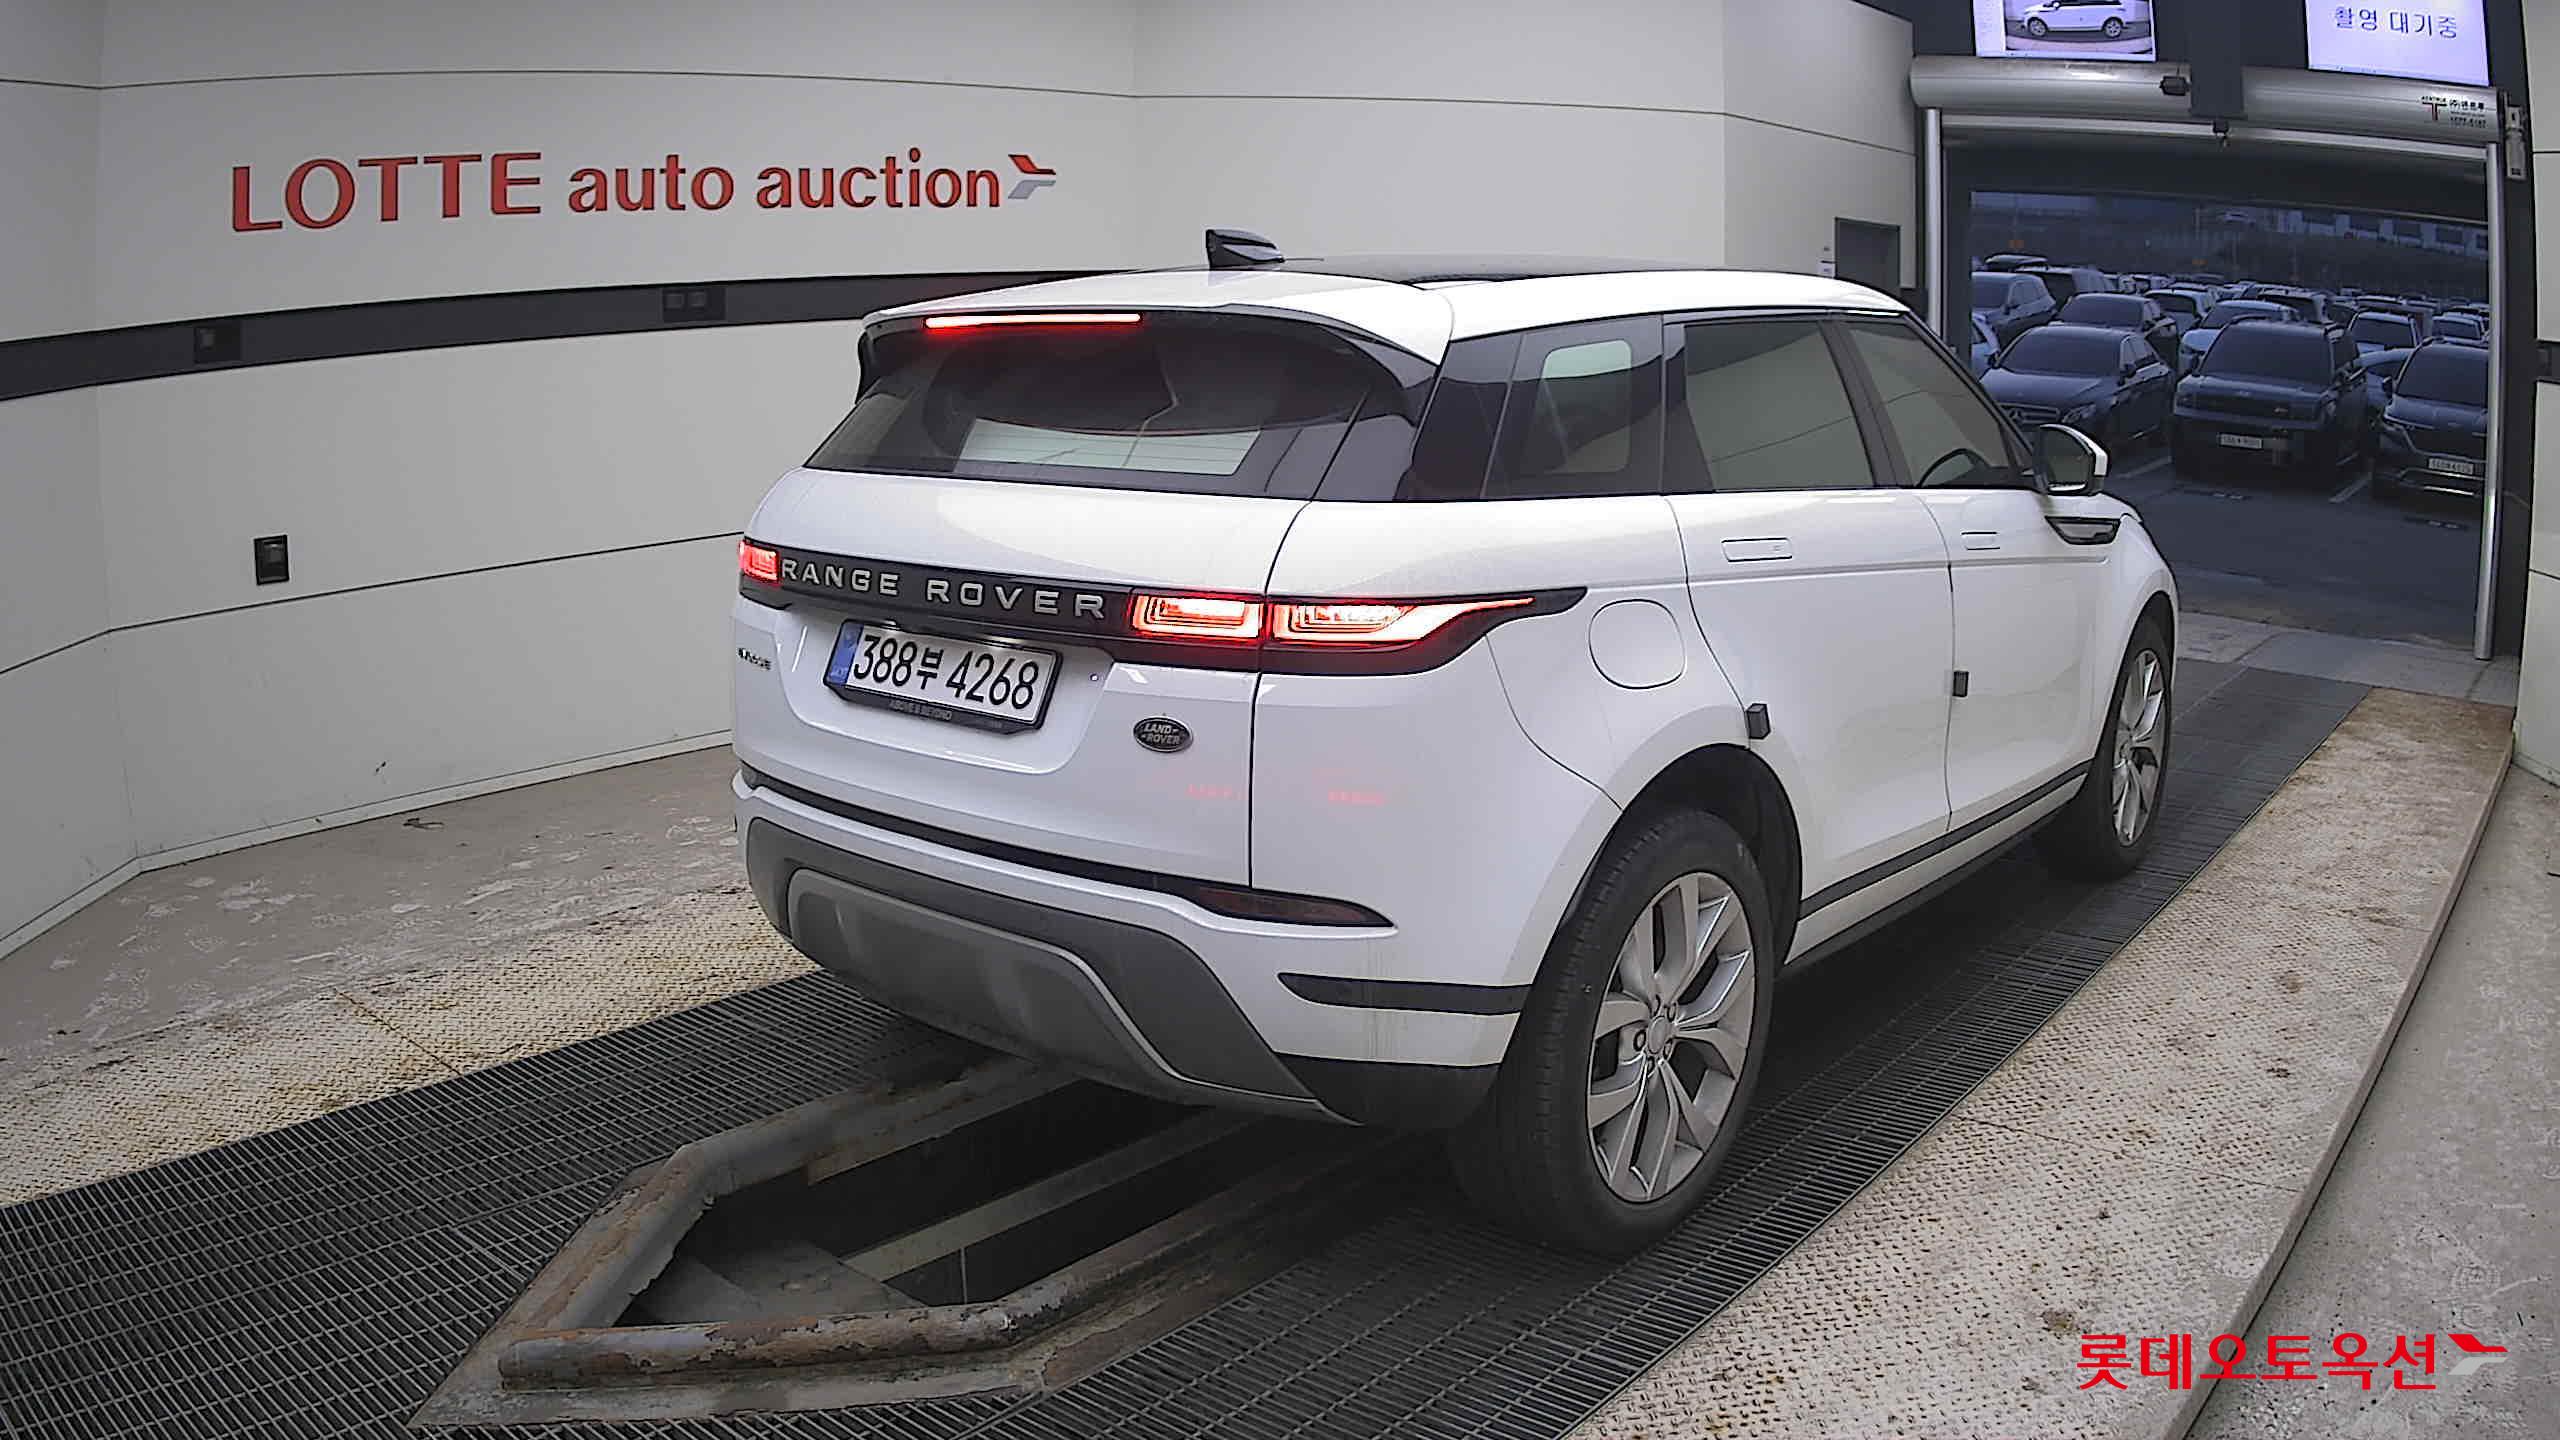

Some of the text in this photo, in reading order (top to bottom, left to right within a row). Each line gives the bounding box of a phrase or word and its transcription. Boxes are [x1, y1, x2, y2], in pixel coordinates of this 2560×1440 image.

[2335, 7, 2457, 39] 촬영 대기 중
[233, 147, 1002, 233] LOTTE auto auction
[781, 559, 1104, 619] RANGE ROVER
[853, 633, 1039, 709] 388부 4268
[1144, 723, 1172, 734] LAND
[1147, 733, 1180, 745] ROVER
